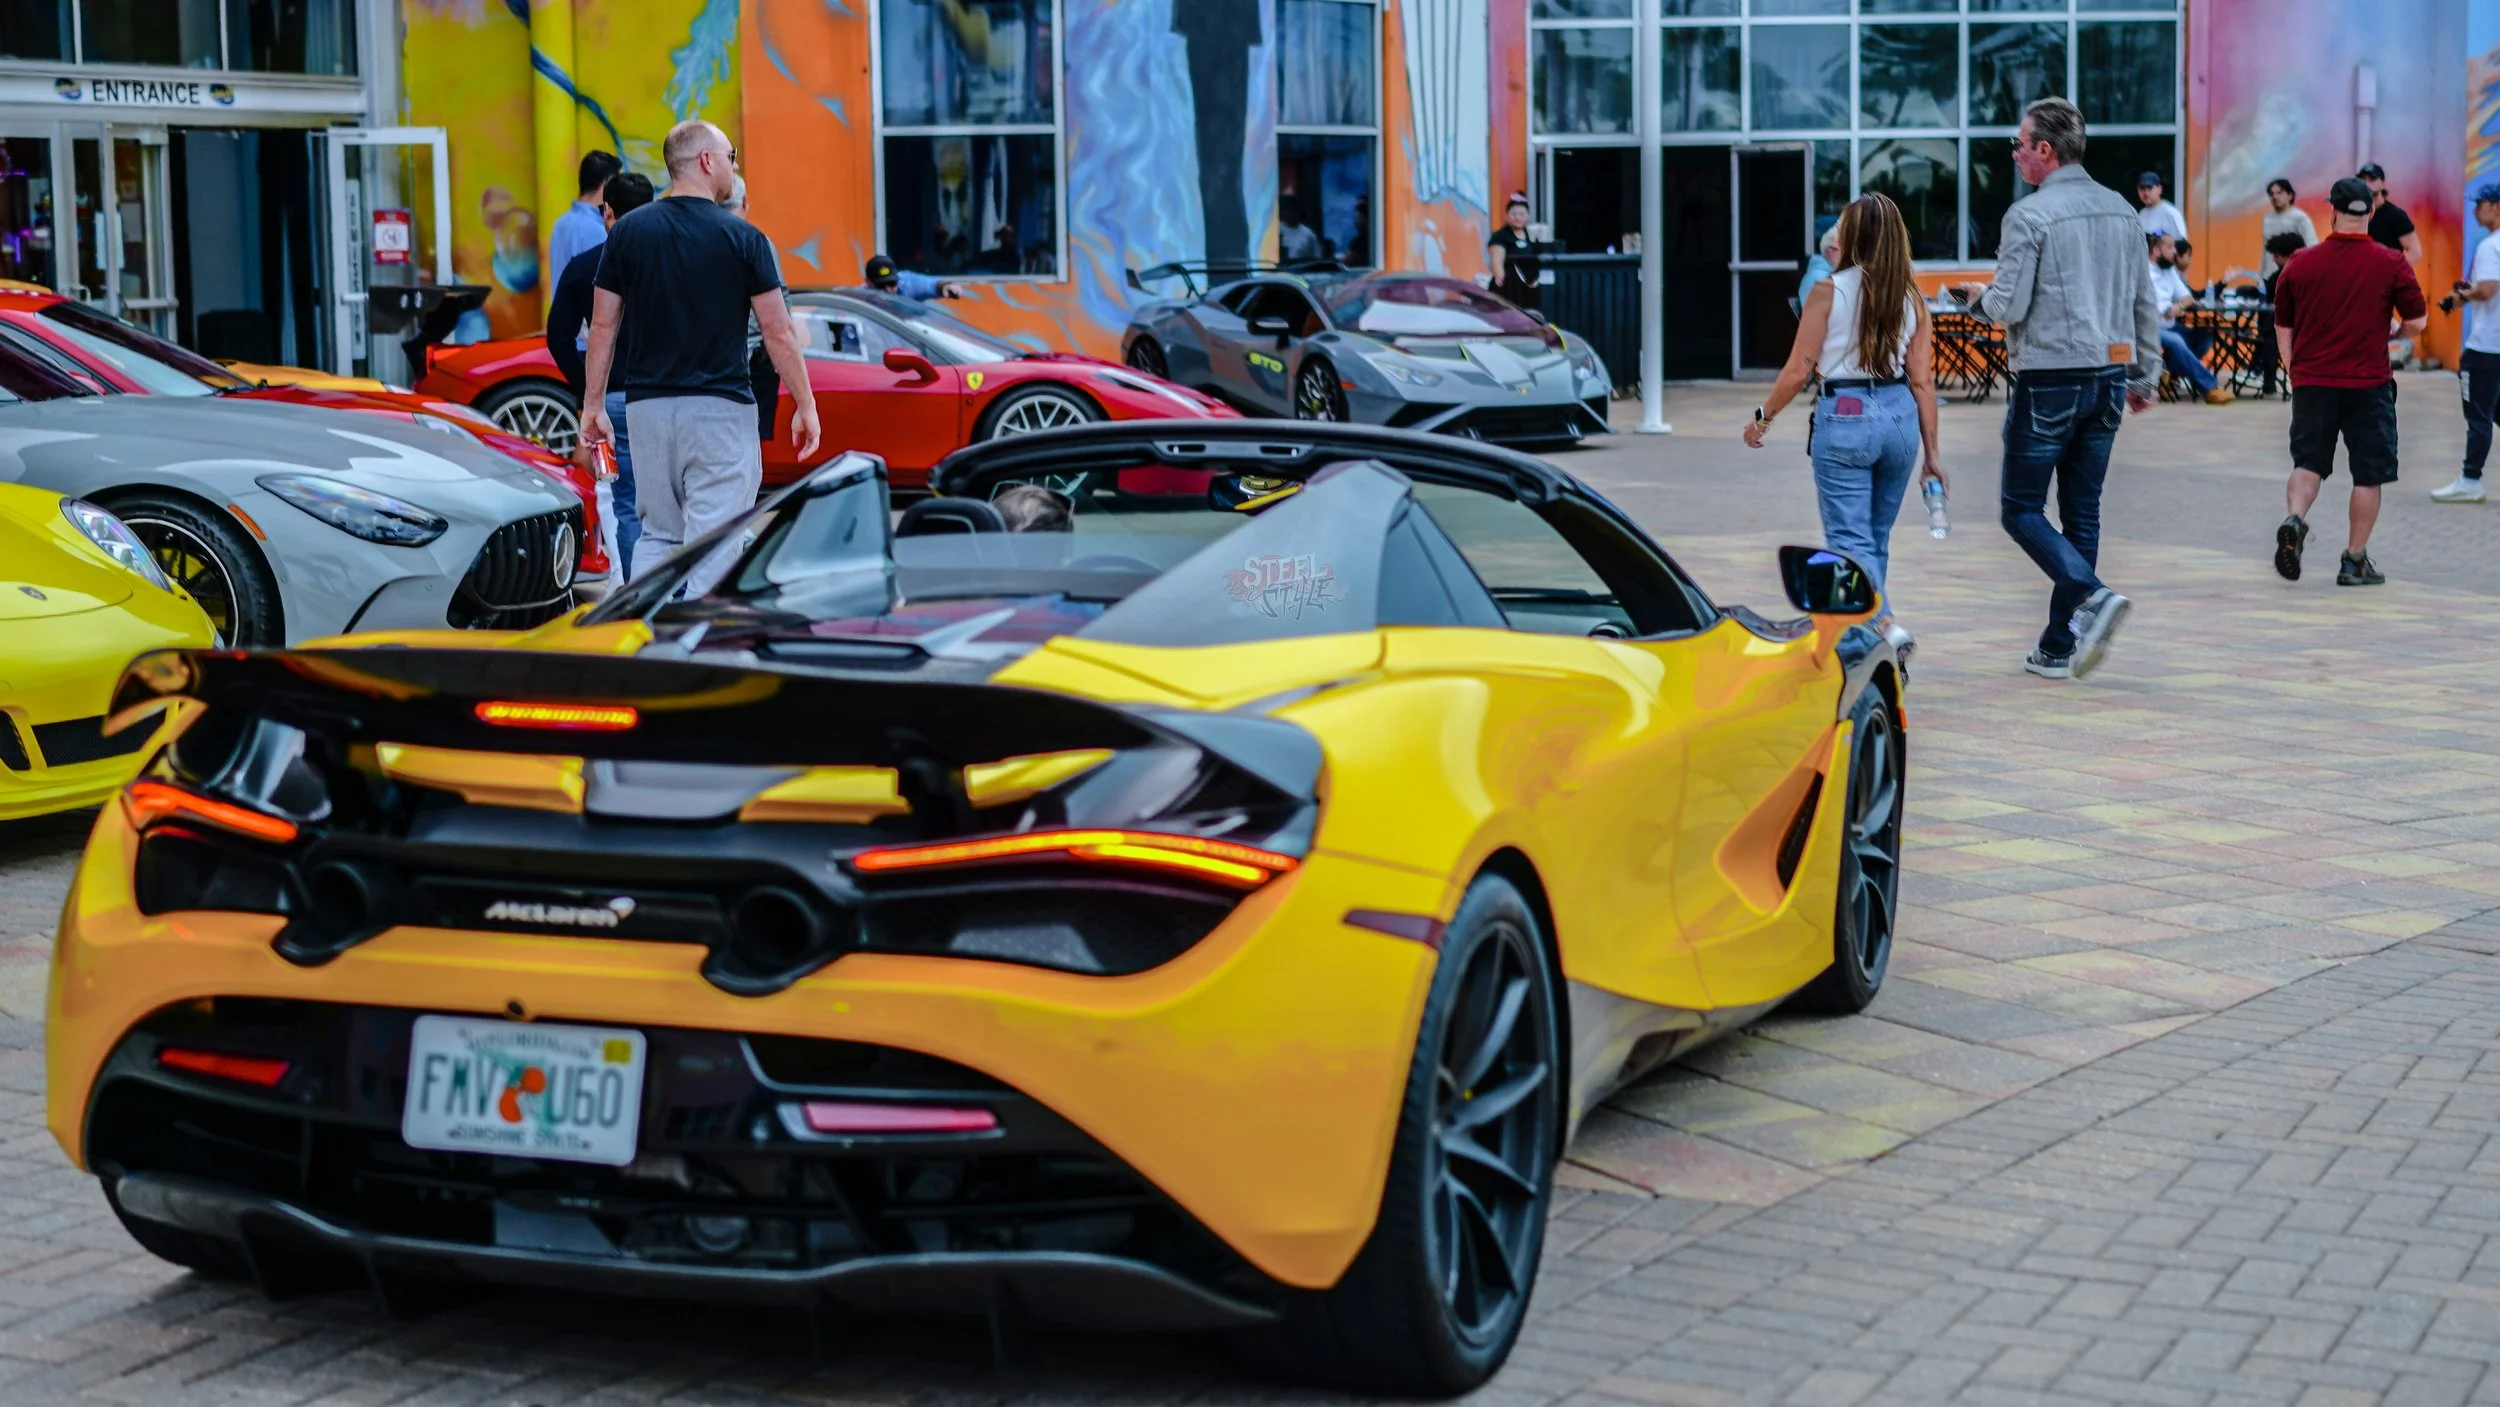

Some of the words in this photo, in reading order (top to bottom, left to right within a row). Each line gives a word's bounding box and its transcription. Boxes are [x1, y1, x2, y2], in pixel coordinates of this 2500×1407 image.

[92, 79, 200, 104] ENTRANCE
[484, 902, 619, 928] McLaren
[547, 1064, 624, 1129] U60
